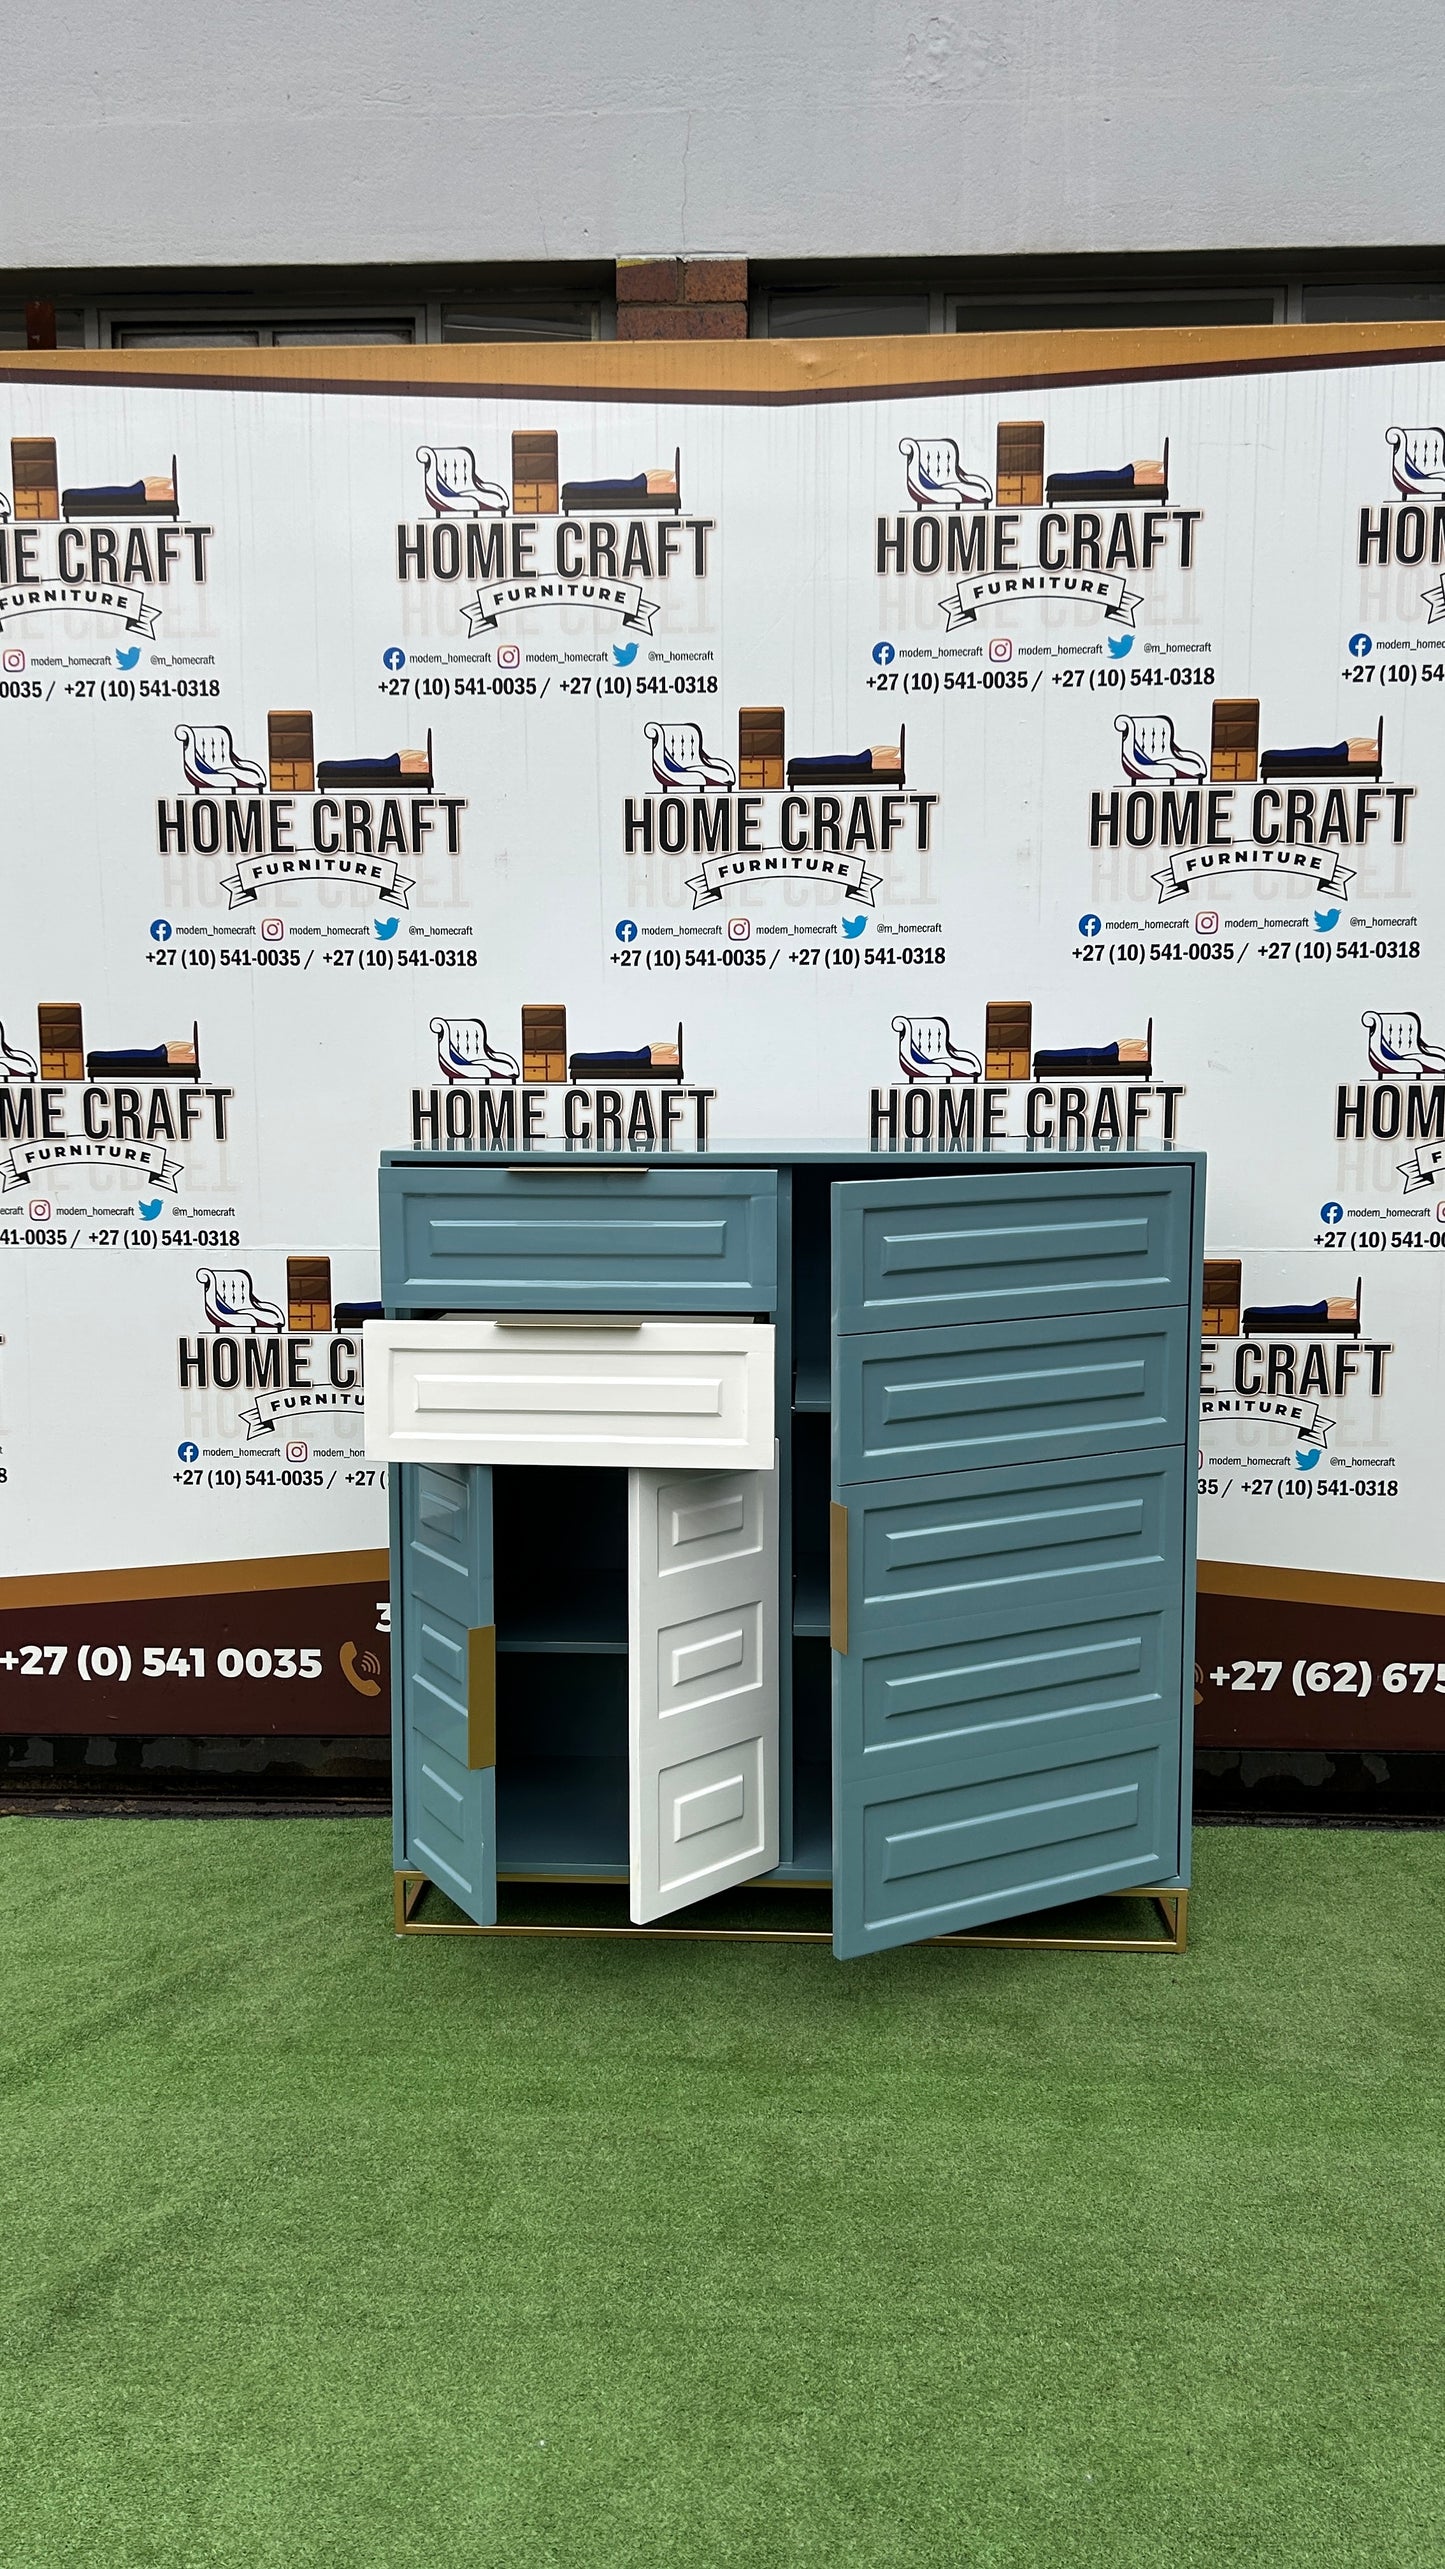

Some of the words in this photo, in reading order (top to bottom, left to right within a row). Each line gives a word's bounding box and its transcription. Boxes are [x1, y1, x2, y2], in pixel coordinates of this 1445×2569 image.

[396, 522, 539, 581] HOME
[555, 519, 715, 579] CRAFT
[876, 514, 1020, 575] HOME
[1038, 510, 1203, 572] CRAFT
[57, 526, 212, 584] CRAFT
[493, 584, 626, 606] FURNITURE
[973, 576, 1110, 600] FURNITURE
[0, 589, 128, 611] FURNITURE
[647, 650, 714, 664] @m_homecraft
[1143, 641, 1212, 655] @m_homecraft
[149, 654, 216, 667] @m_homecraft
[865, 673, 899, 691] +27
[903, 672, 940, 695] (10)
[943, 670, 1029, 690] 541-0035
[1051, 669, 1085, 688] +27
[1089, 668, 1126, 692] (10)
[1130, 667, 1215, 687] 541-0318
[1341, 665, 1376, 683] +27
[1379, 664, 1417, 687] (10)
[64, 680, 96, 698] +27
[100, 680, 136, 702] (10)
[139, 679, 221, 698] 541-0318
[378, 678, 411, 696] +27
[414, 677, 450, 700] (10)
[454, 677, 537, 696] 541-0035
[559, 676, 592, 695] +27
[596, 676, 632, 699] (10)
[636, 675, 718, 695] 541-0318
[156, 798, 296, 855] HOME
[312, 797, 467, 855] CRAFT
[623, 797, 763, 854] HOME
[780, 794, 938, 852] CRAFT
[1089, 789, 1234, 848] HOME
[1251, 787, 1416, 846] CRAFT
[252, 857, 383, 879] FURNITURE
[717, 857, 850, 879] FURNITURE
[1186, 850, 1322, 872] FURNITURE
[408, 925, 474, 938] @m_homecraft
[876, 922, 943, 936] @m_homecraft
[1349, 915, 1418, 929] @m_homecraft
[145, 948, 177, 966] +27
[181, 949, 216, 970] (10)
[220, 949, 301, 967] 541-0035
[322, 949, 355, 967] +27
[358, 949, 394, 971] (10)
[397, 949, 478, 967] 541-0318
[609, 949, 642, 967] +27
[645, 949, 681, 971] (10)
[684, 949, 767, 967] 541-0035
[788, 948, 821, 966] +27
[824, 948, 860, 970] (10)
[863, 946, 946, 965] 541-0318
[1071, 944, 1105, 962] +27
[1109, 943, 1146, 966] (10)
[1149, 942, 1235, 961] 541-0035
[1257, 942, 1291, 960] +27
[1295, 941, 1332, 964] (10)
[1335, 940, 1421, 959] 541-0318
[82, 1086, 233, 1141] CRAFT
[411, 1089, 547, 1140] HOME
[563, 1088, 715, 1140] CRAFT
[869, 1087, 1008, 1139] HOME
[1026, 1085, 1184, 1139] CRAFT
[24, 1144, 152, 1164] FURNITURE
[171, 1206, 236, 1219] @m_homecraft
[88, 1229, 120, 1246] +27
[123, 1229, 158, 1250] (10)
[161, 1229, 240, 1247] 541-0318
[1313, 1231, 1347, 1248] +27
[1350, 1231, 1387, 1252] (10)
[179, 1337, 313, 1389] HOME
[1234, 1342, 1393, 1397] CRAFT
[1329, 1456, 1396, 1469] @m_homecraft
[172, 1469, 204, 1486] +27
[207, 1469, 242, 1490] (10)
[245, 1469, 324, 1486] 541-0035
[344, 1470, 376, 1487] +27
[1240, 1478, 1274, 1496] +27
[1277, 1479, 1313, 1500] (10)
[1316, 1479, 1399, 1497] 541-0318
[77, 1644, 132, 1682] (0)
[142, 1647, 205, 1678] 541
[217, 1648, 323, 1679] 0035
[1209, 1660, 1283, 1691] +27
[1292, 1660, 1372, 1698] (62)
